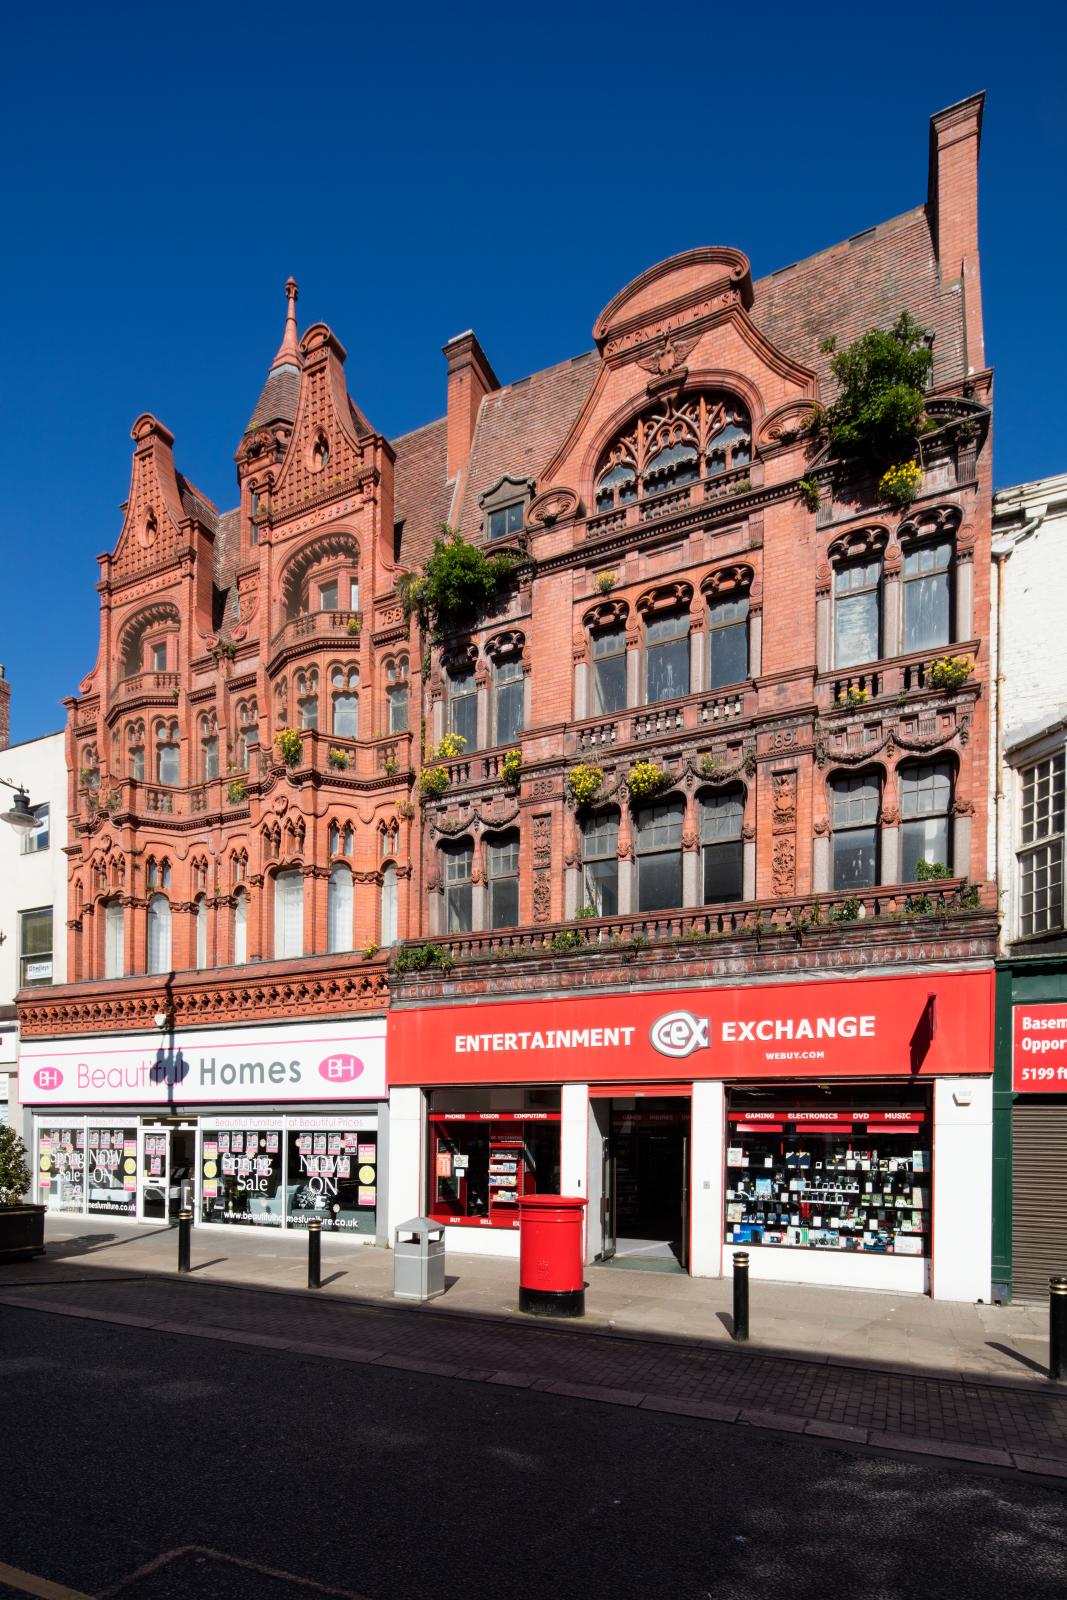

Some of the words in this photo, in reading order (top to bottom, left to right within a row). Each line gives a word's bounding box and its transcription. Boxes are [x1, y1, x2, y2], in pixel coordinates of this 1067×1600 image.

[768, 727, 799, 751] 1891
[455, 1027, 635, 1053] ENTERTAINMENT
[721, 1016, 876, 1042] EXCHANGE
[765, 1051, 825, 1060] WEBUY.COM
[77, 1058, 185, 1089] Beautiful
[199, 1058, 302, 1086] Homes
[327, 1058, 355, 1079] BH
[1022, 1068, 1054, 1080] 5199
[38, 1071, 59, 1087] BH
[216, 1118, 248, 1127] Beautiful
[249, 1118, 282, 1127] Furniture
[288, 1119, 297, 1127] at
[299, 1117, 335, 1127] Beautiful
[337, 1118, 363, 1127] Prices
[88, 1149, 123, 1165] NOW
[222, 1152, 273, 1177] Spring
[299, 1155, 350, 1173] NOW
[59, 1167, 80, 1182] Sale
[237, 1174, 268, 1192] Sale
[308, 1177, 339, 1195] ON
